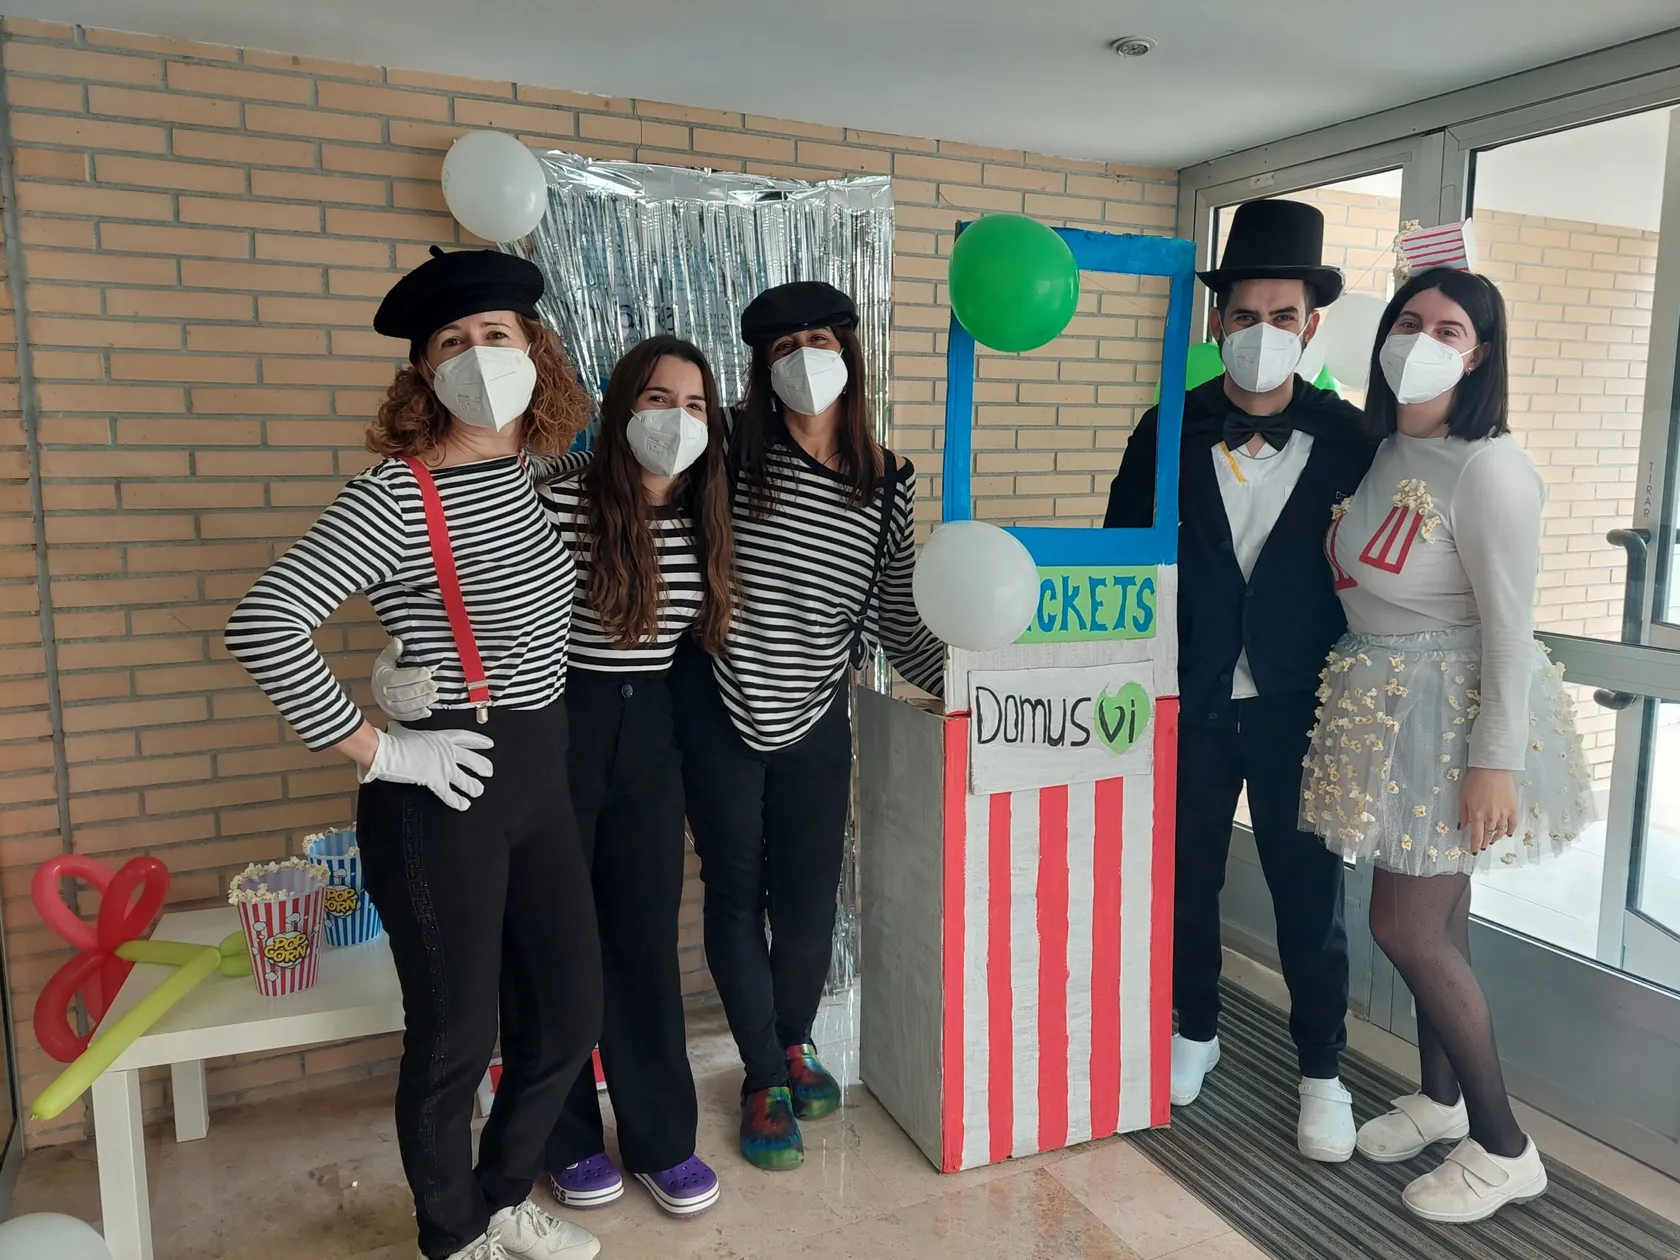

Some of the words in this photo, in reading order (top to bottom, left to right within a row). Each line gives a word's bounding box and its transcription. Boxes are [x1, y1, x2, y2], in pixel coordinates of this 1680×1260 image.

[1643, 461, 1654, 518] TIRAR
[1026, 575, 1156, 633] CKETS
[326, 888, 356, 902] POP
[325, 898, 357, 912] ORN
[273, 933, 306, 951] POP
[263, 944, 309, 963] CORN
